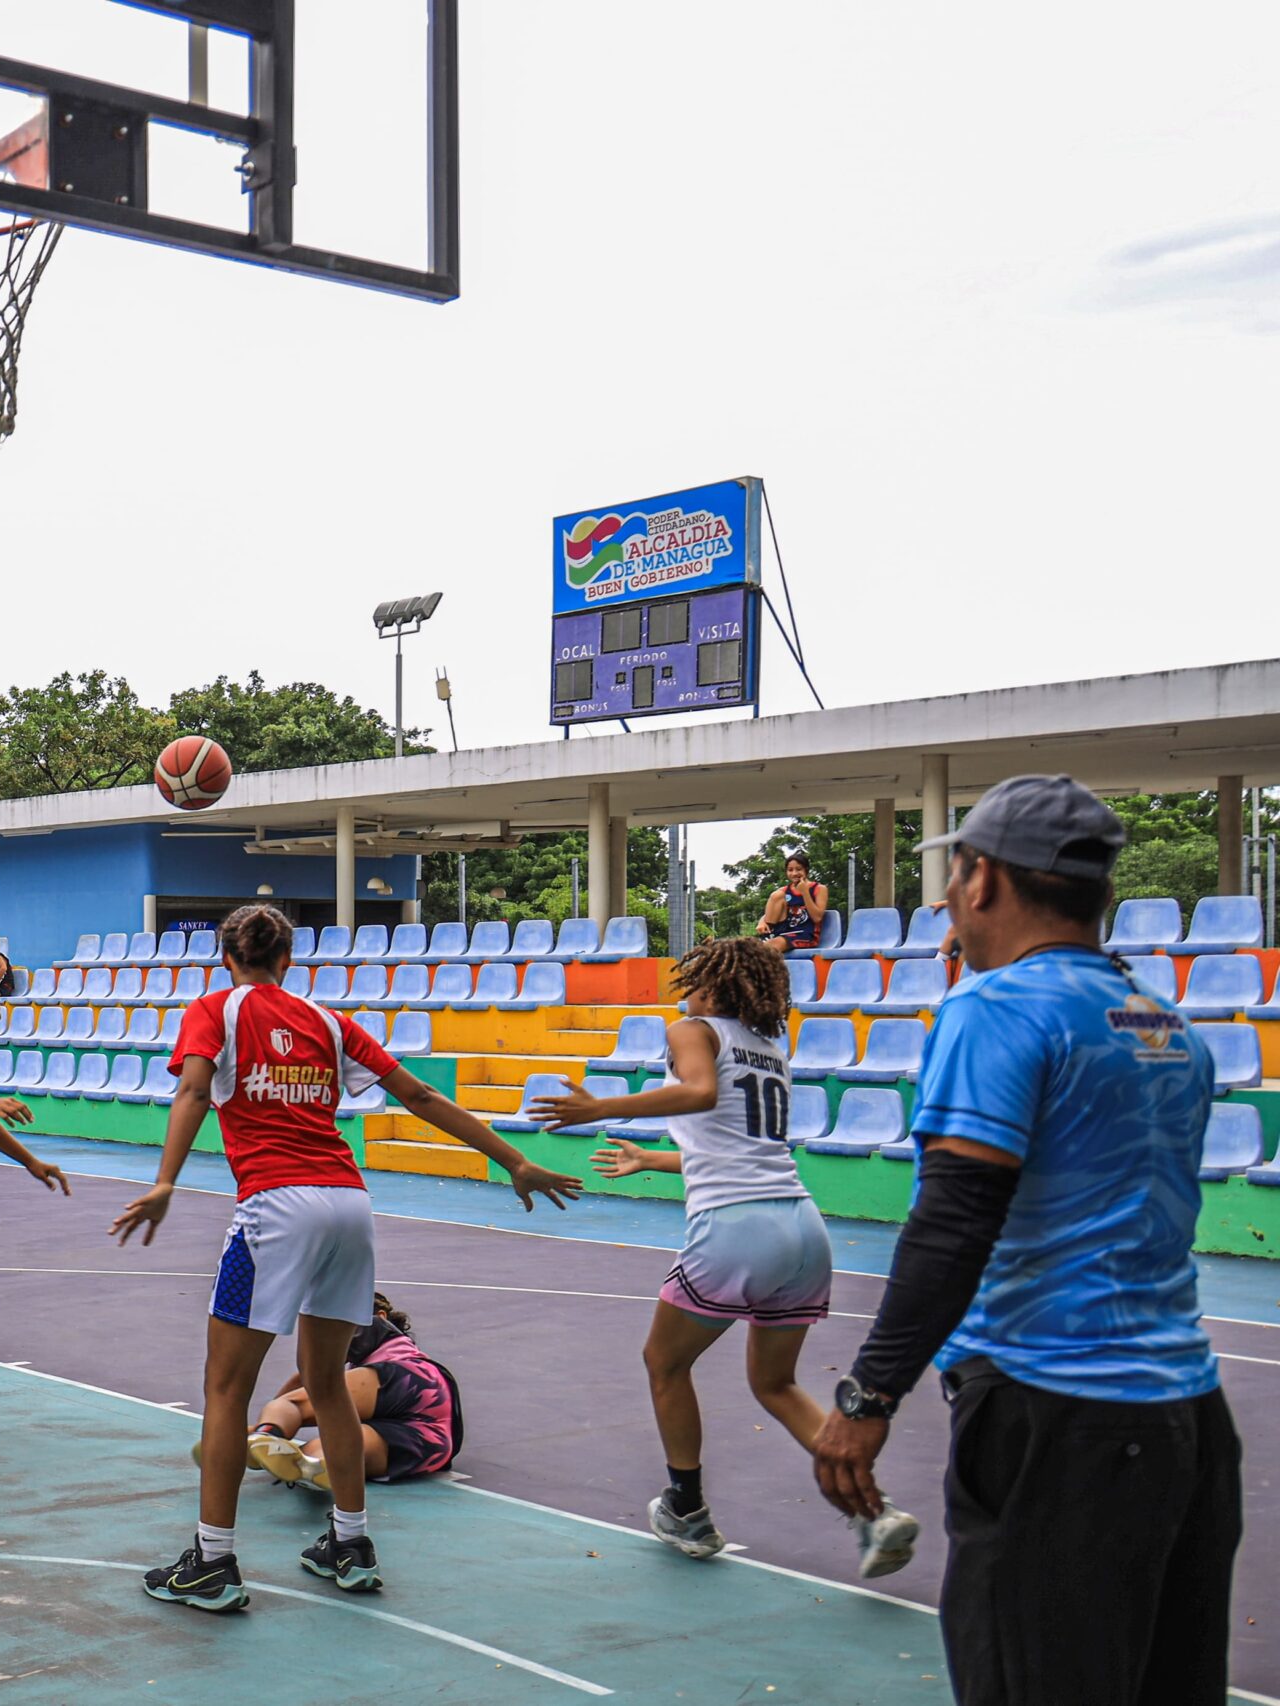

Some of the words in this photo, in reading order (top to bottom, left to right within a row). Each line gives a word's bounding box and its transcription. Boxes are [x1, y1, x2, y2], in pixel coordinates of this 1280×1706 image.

[647, 510, 680, 526] PODER
[647, 513, 706, 536] CIUDADANO
[628, 516, 728, 559] ALCALDÍA
[613, 560, 636, 579] DE
[641, 537, 729, 572] MANAGUA
[587, 580, 622, 598] BUEN
[698, 622, 740, 639] VISITA
[178, 921, 209, 930] SANKEY
[732, 1046, 749, 1065] SAN
[733, 1072, 788, 1142] 10
